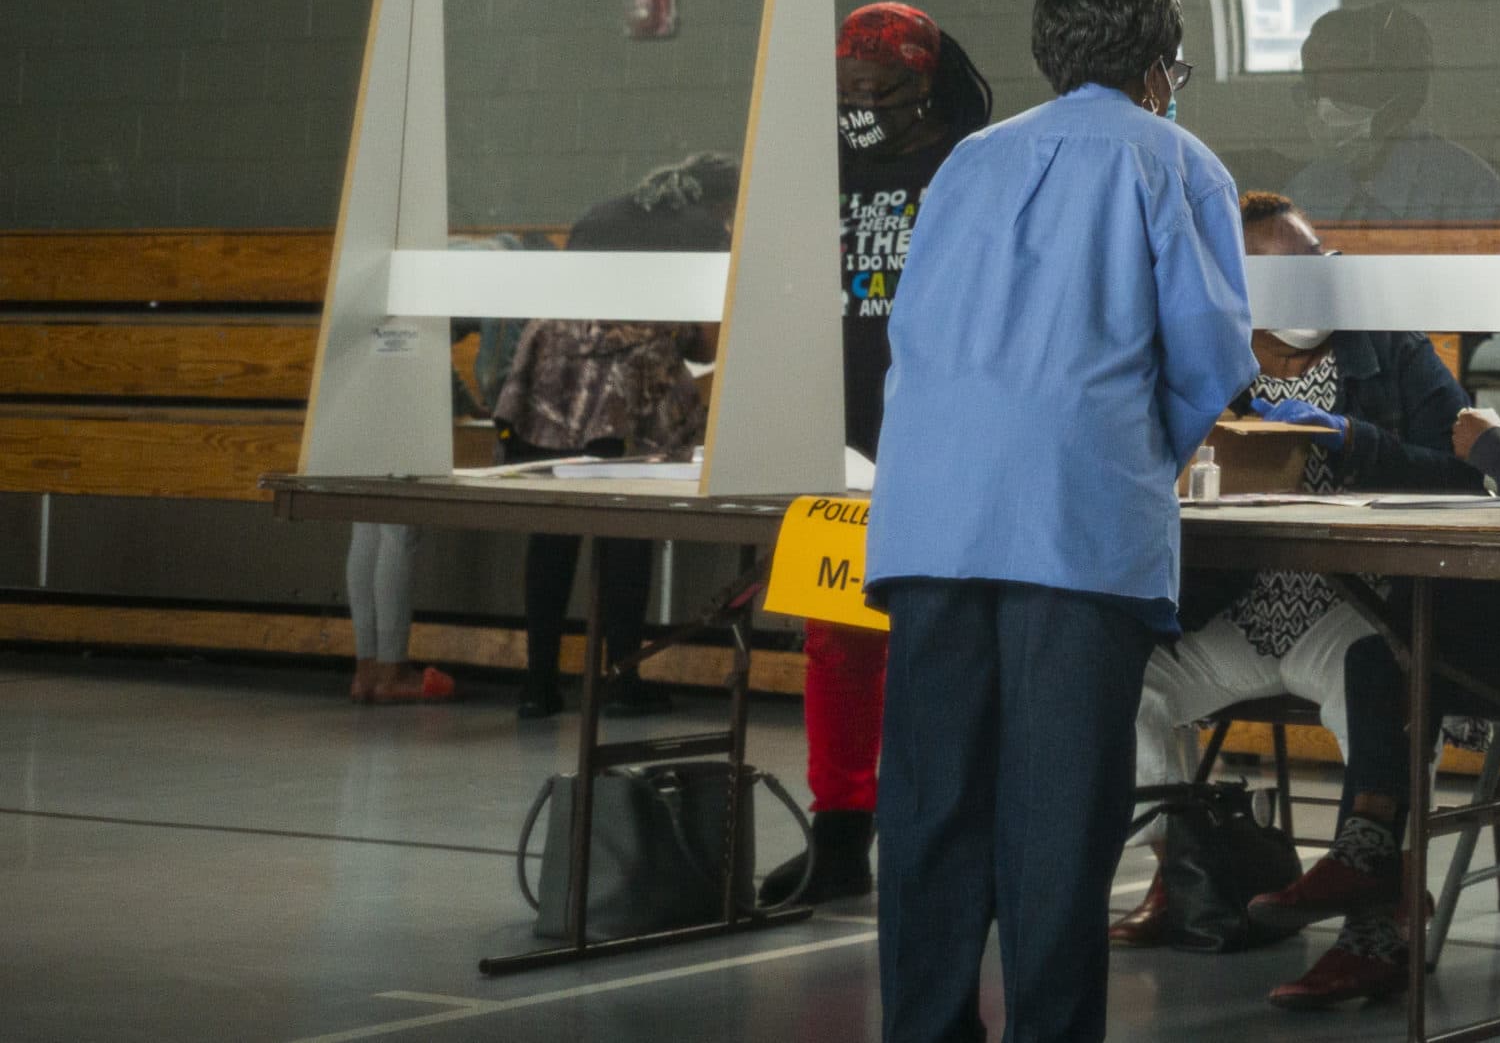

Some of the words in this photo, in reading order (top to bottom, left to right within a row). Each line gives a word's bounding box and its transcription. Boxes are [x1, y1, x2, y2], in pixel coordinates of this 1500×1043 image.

[848, 110, 875, 129] Me
[873, 189, 907, 206] DO
[851, 206, 886, 219] LIKE
[858, 216, 910, 231] HERE
[846, 255, 854, 271] I
[858, 255, 882, 271] DO
[817, 556, 867, 595] M-
